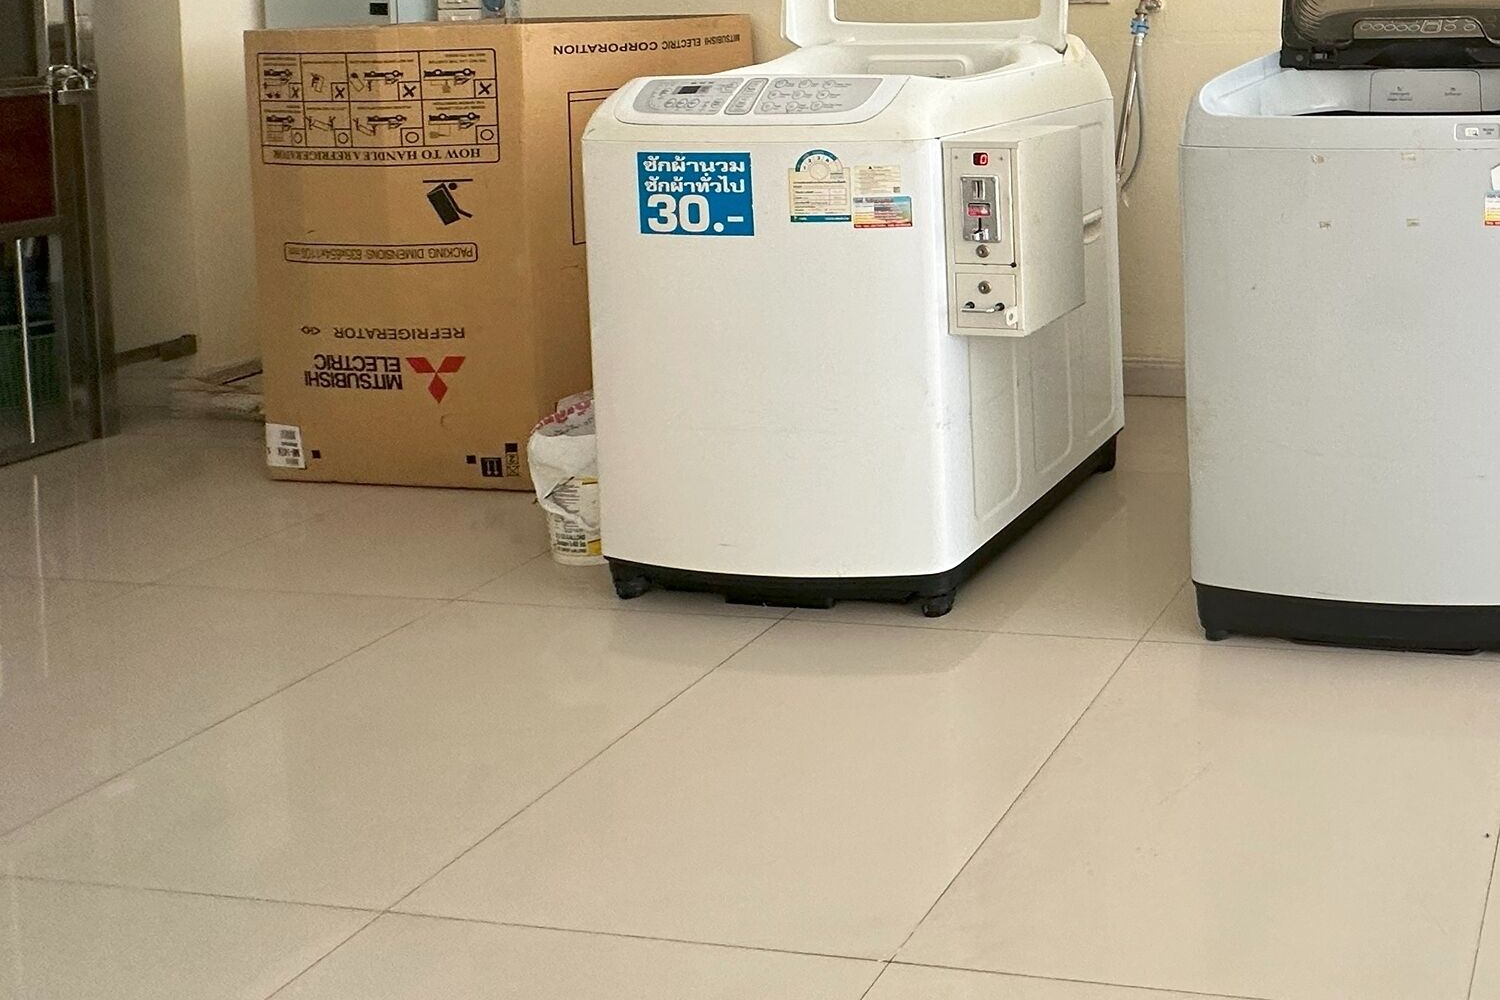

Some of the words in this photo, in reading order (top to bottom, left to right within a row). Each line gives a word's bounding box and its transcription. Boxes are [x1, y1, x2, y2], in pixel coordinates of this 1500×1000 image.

[553, 41, 658, 55] CORPORATION
[661, 37, 701, 50] ELECTRIC
[363, 150, 417, 161] HANDLE
[421, 149, 442, 159] TO
[444, 148, 480, 159] HOW
[643, 155, 745, 172] ซักผ้านวม
[644, 173, 745, 193] ซักผ้าทั่วไป
[647, 194, 744, 233] 30.-
[367, 248, 424, 260] DIMENSIONS
[429, 247, 473, 258] PACKING
[334, 327, 465, 339] REFRIGERATOR
[314, 354, 401, 372] ELECTRIC
[304, 370, 403, 390] MITSUBISHI
